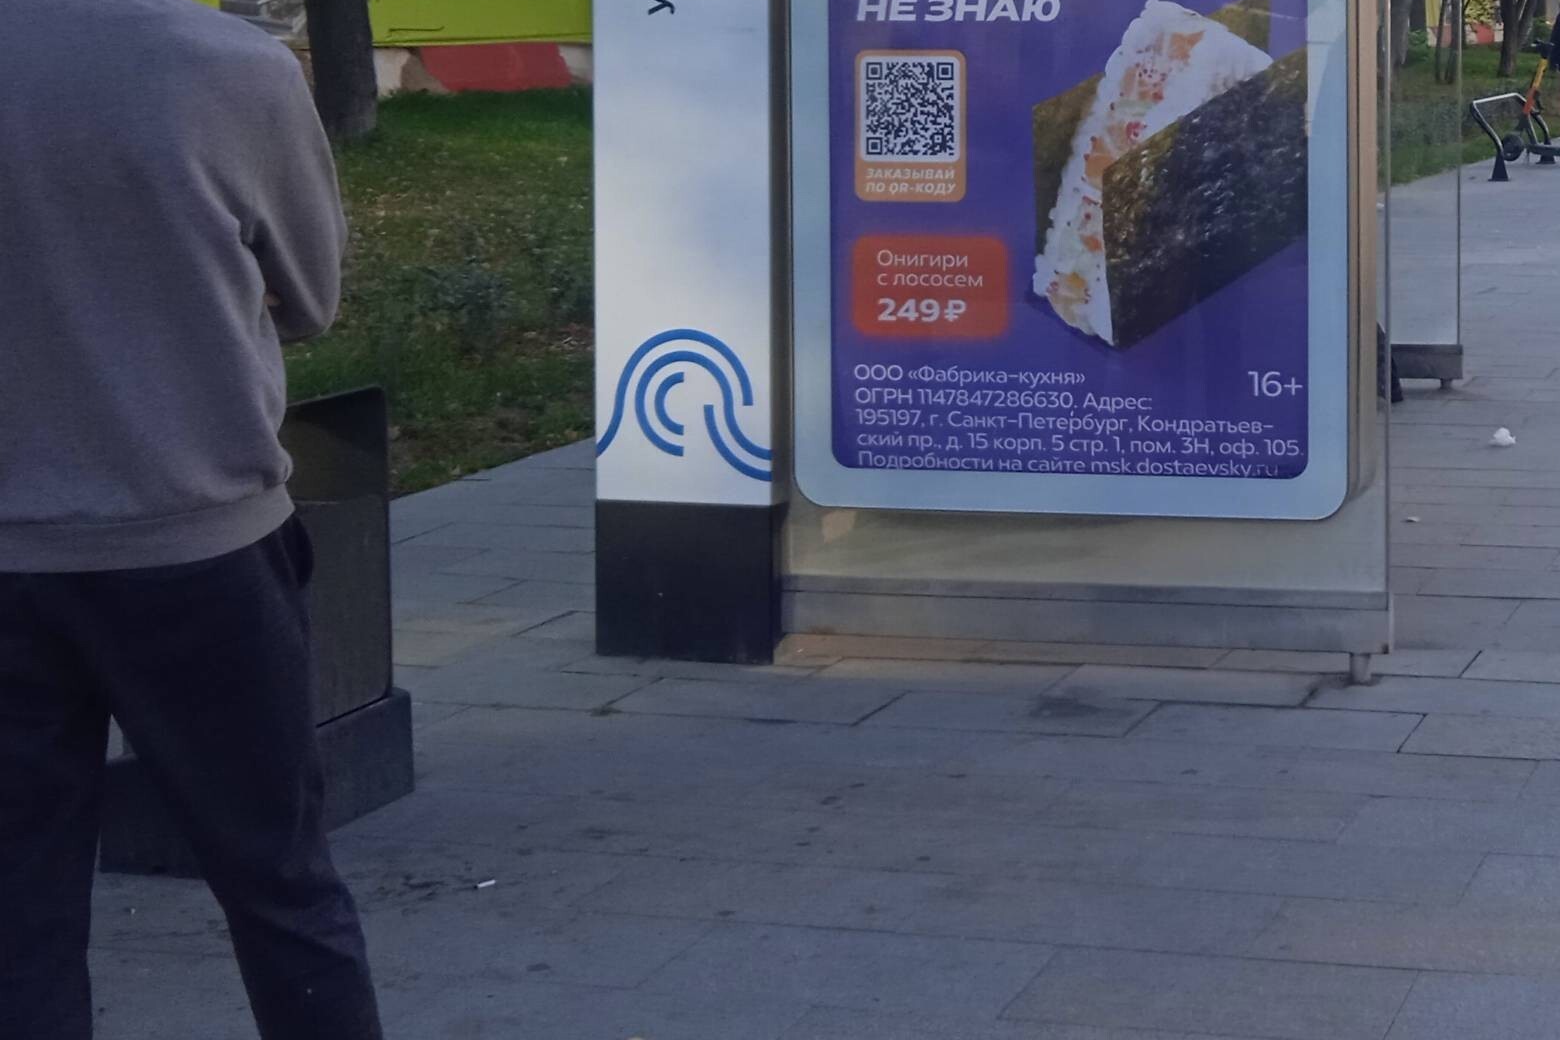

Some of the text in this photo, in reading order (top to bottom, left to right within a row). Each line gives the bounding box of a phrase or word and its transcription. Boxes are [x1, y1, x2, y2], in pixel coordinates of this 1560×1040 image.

[865, 166, 956, 180] ЗАКАЗЫВАЙ
[865, 182, 956, 196] ПО QR-КОДУ
[876, 249, 969, 271] Онигири
[876, 273, 984, 288] с лососем
[854, 364, 1086, 390] ООО «Фабрика-кухня»
[1247, 370, 1303, 398] 16+
[855, 387, 1153, 414] ОГРН 1147847286630. Адрес:
[856, 408, 1275, 437] 195197, г. Санкт-Петербург, Кондратьев-
[856, 431, 1304, 459] ский пр., д. 15 корп. 5 стр. 1, пом. 3Н, оф. 105.
[857, 450, 1279, 478] Подробности на сайте msk.dostaevsky.ru
